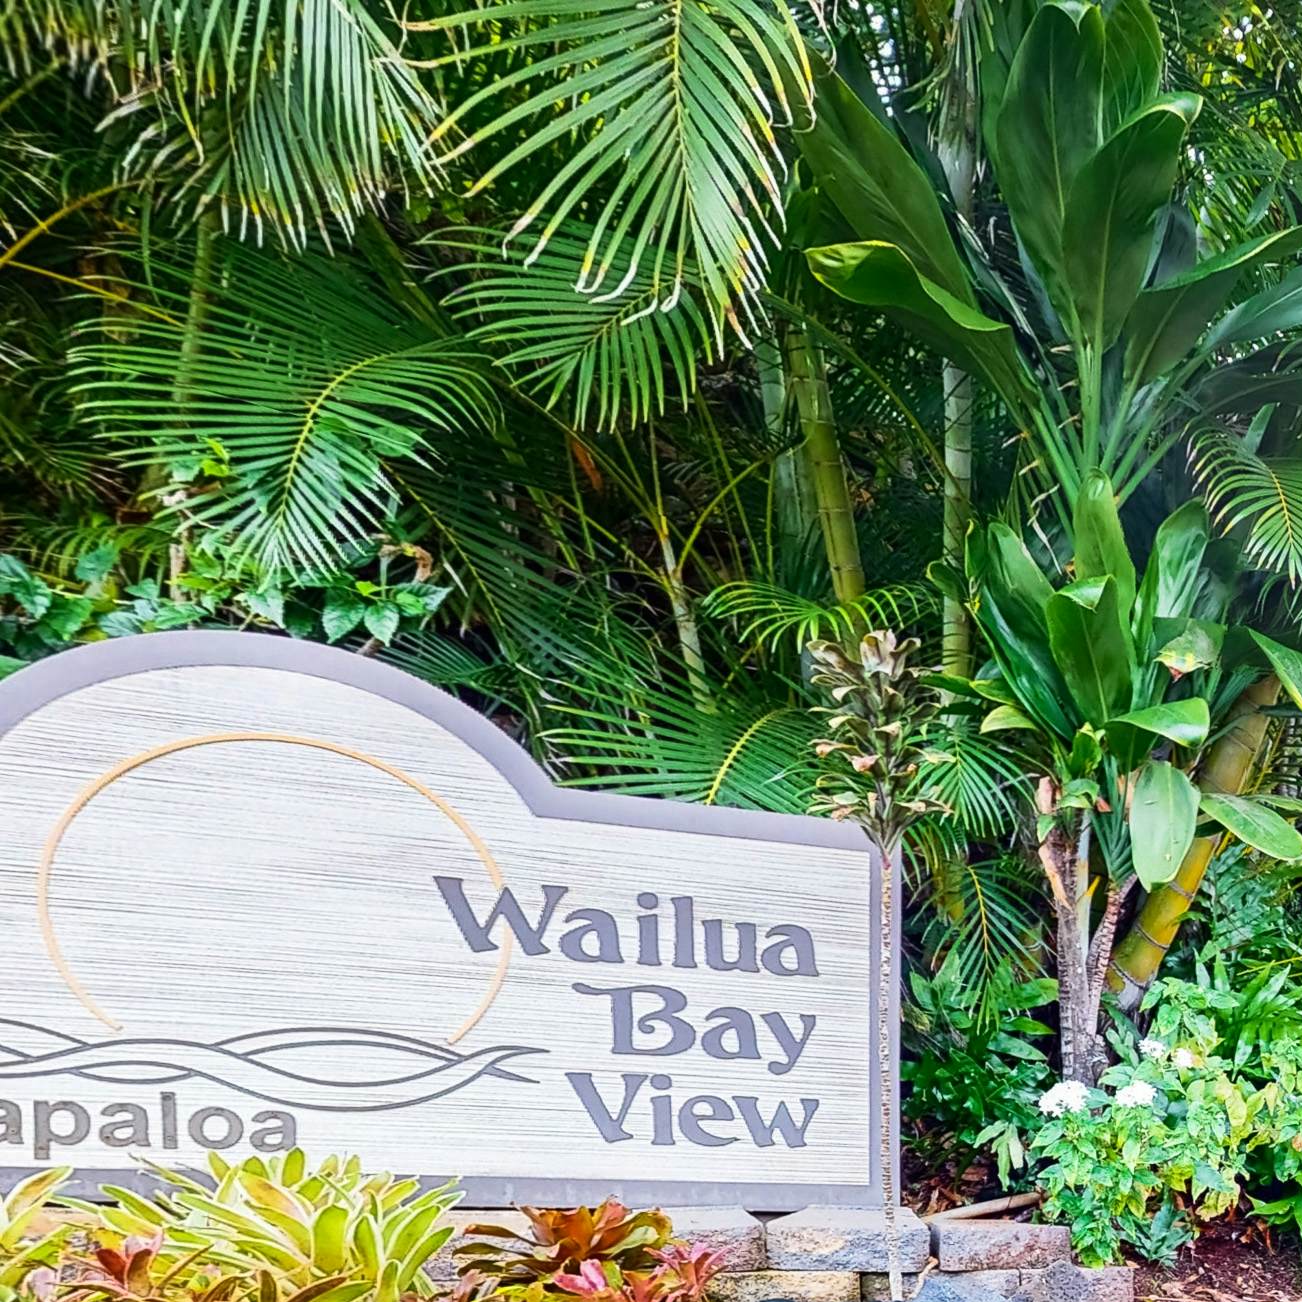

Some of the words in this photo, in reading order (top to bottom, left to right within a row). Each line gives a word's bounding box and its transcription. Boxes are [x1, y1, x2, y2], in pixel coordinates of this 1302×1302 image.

[433, 876, 819, 977] Wailua
[571, 983, 816, 1075] Bay
[565, 1072, 820, 1148] View
